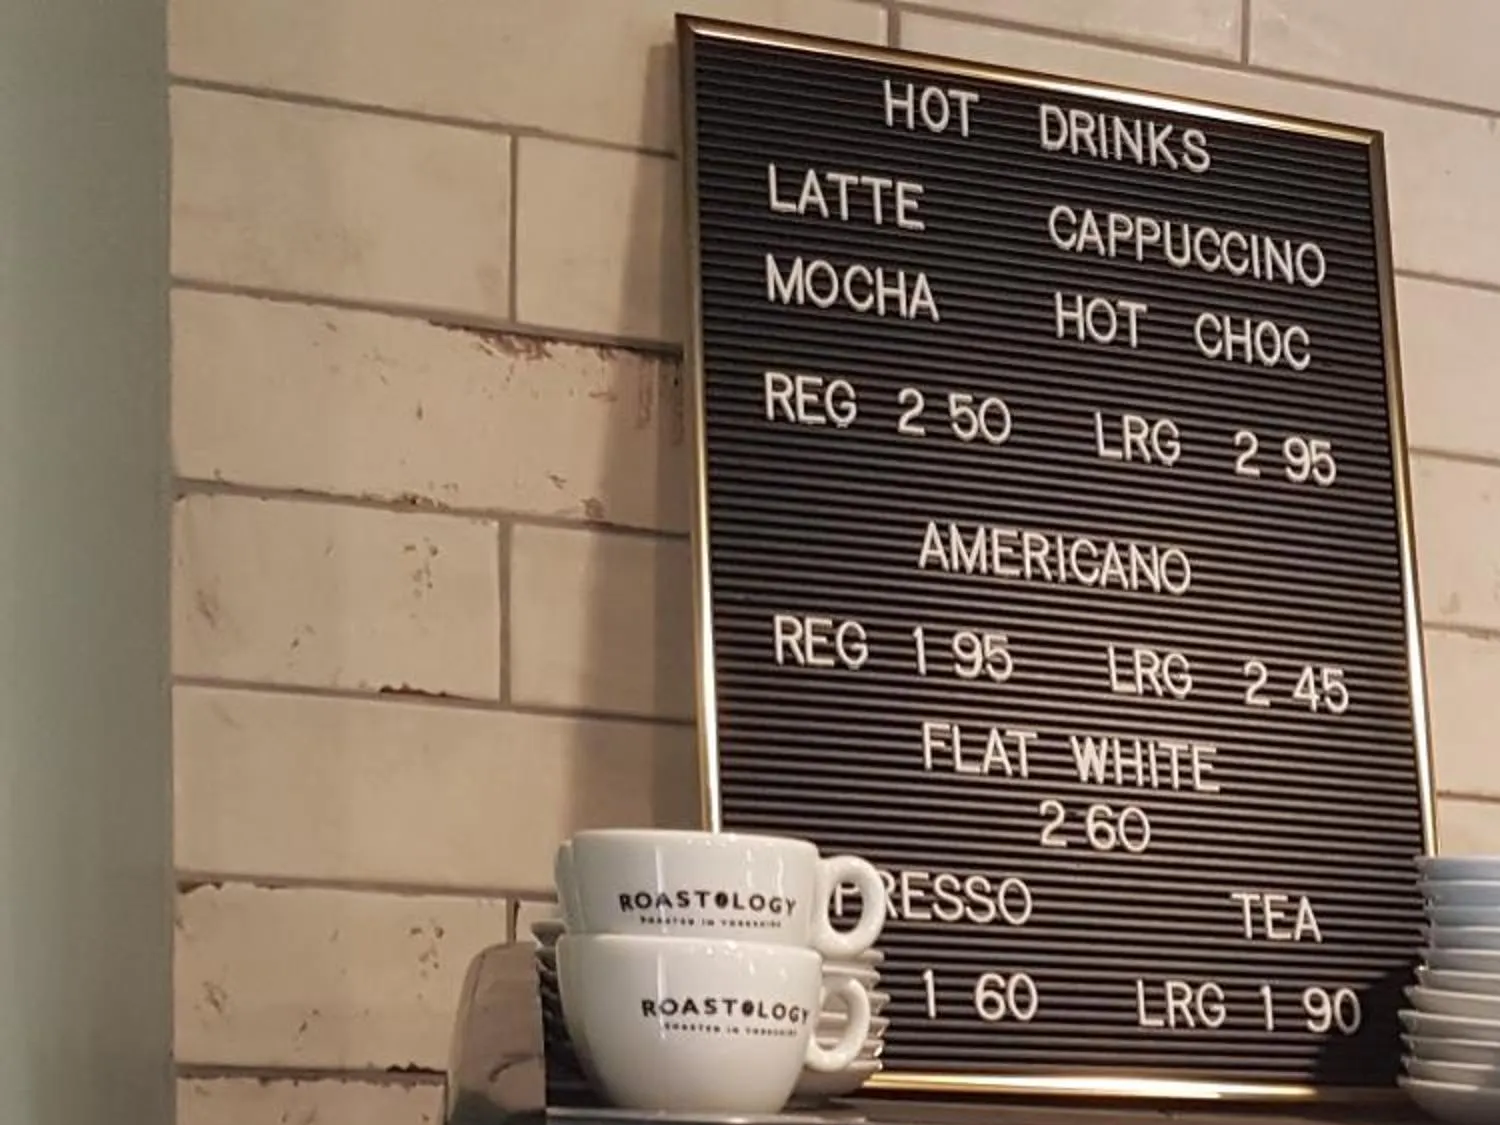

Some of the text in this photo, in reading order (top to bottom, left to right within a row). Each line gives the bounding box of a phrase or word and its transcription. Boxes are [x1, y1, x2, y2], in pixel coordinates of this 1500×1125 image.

[885, 79, 1211, 172] HOT DRINKS
[769, 164, 924, 229] LATTE
[1049, 205, 1325, 286] CAPPUCCINO
[766, 253, 939, 320] MOCHA
[1055, 291, 1311, 370] HOT CHOC
[765, 372, 1336, 485] REG 2 50 LRG 2 95
[919, 521, 1192, 595] AMERICANO
[774, 614, 1349, 713] REG 1 95 LRG 2 45
[923, 722, 1221, 792] FLAT WHITE
[1039, 799, 1151, 852] 2 60
[619, 890, 797, 917] ROASTOLOGY
[1231, 892, 1321, 942] TEA
[923, 969, 1038, 1020] 1 60
[1137, 979, 1358, 1032] LRG 1 90
